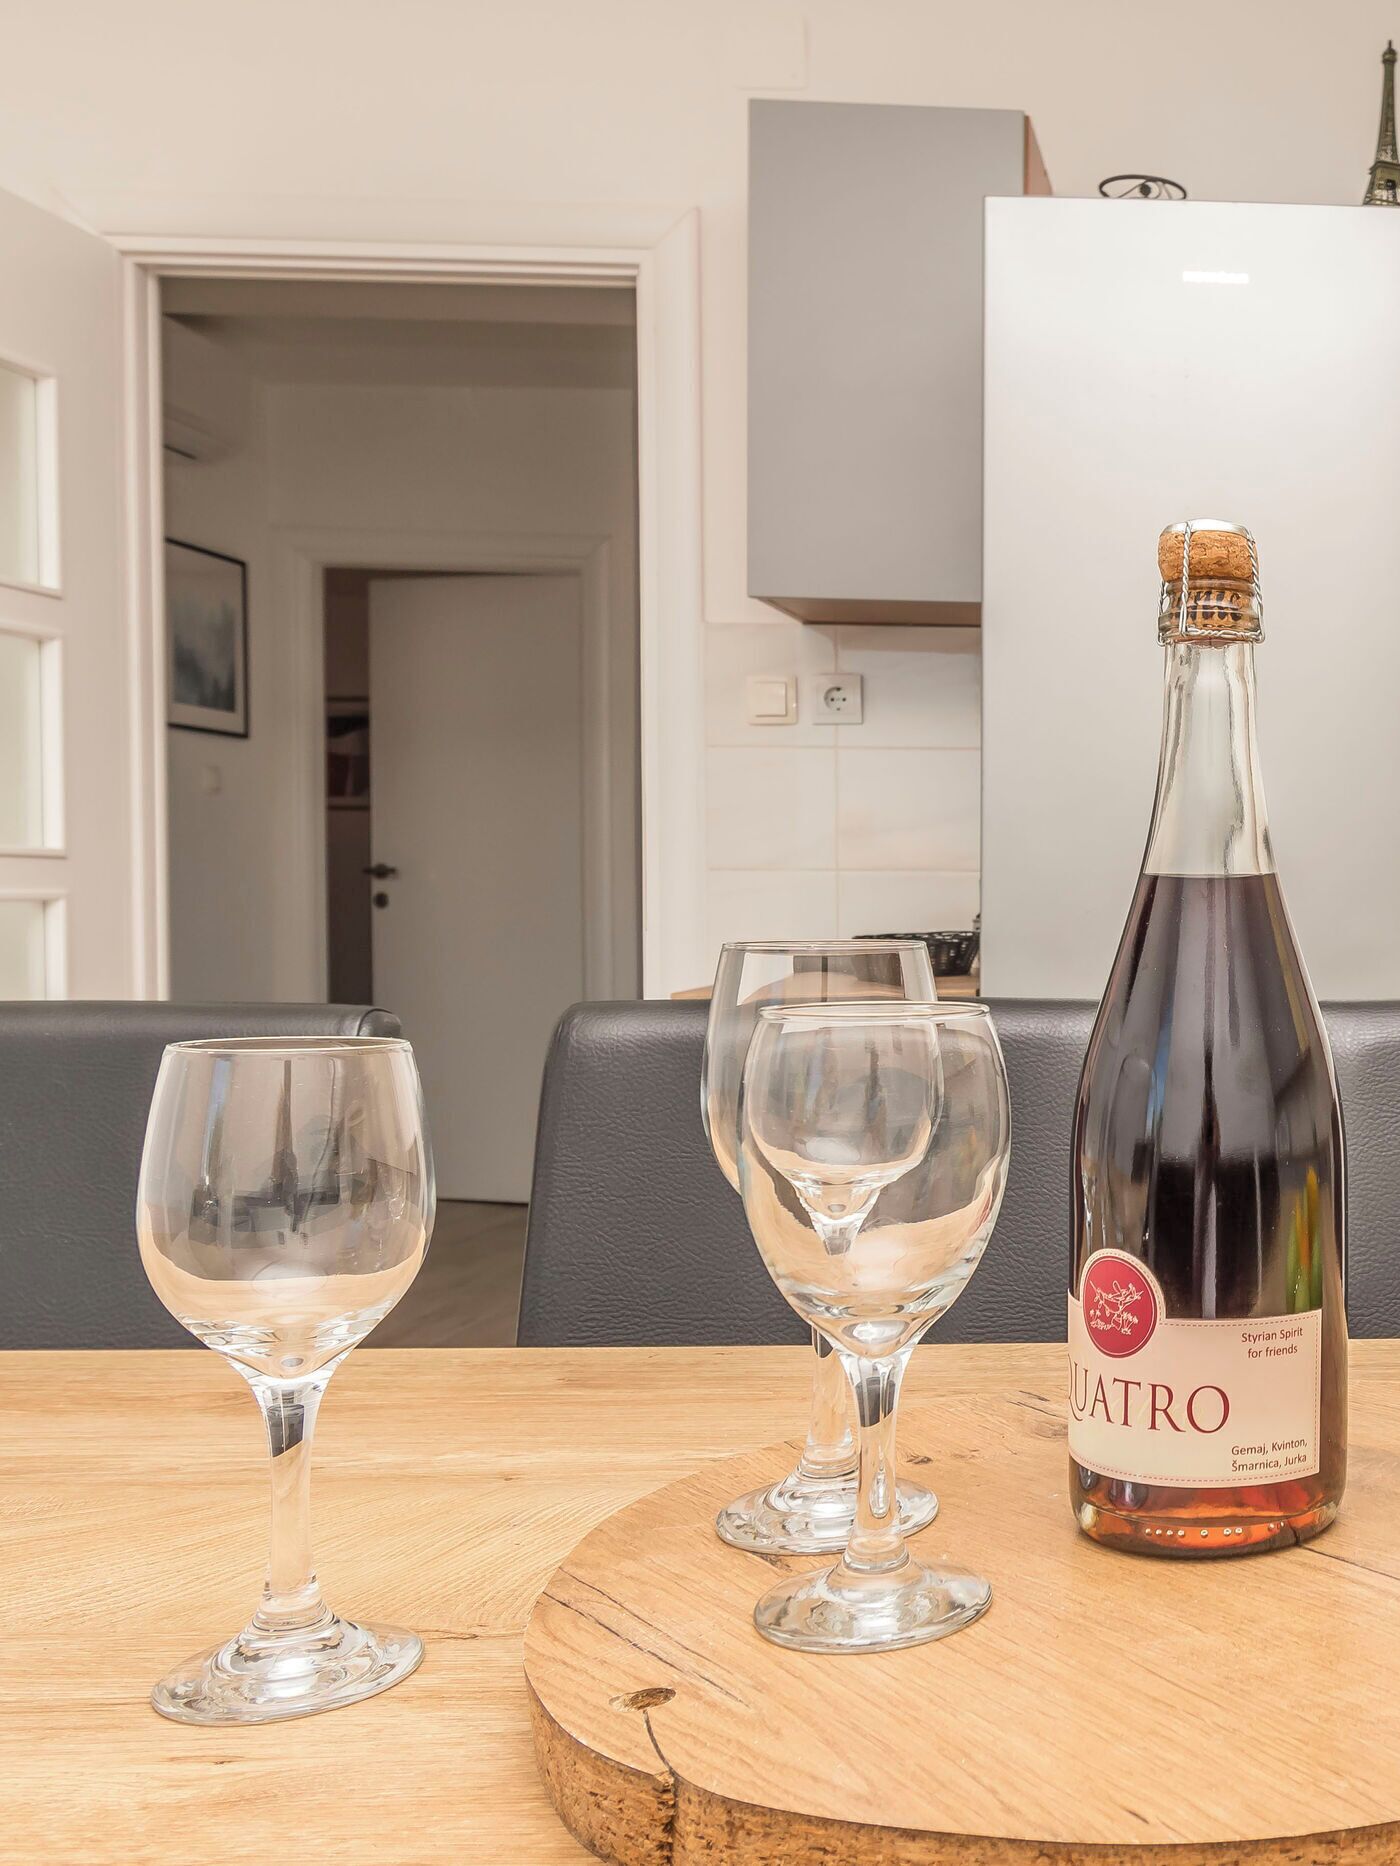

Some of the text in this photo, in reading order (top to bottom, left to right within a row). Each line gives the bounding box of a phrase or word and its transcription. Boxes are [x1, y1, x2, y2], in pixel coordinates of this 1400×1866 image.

[1241, 1327, 1304, 1345] Styrian Spirit
[1247, 1343, 1298, 1359] for friends
[1231, 1438, 1308, 1456] Gemaj, Kvinton,
[1231, 1453, 1307, 1473] Šmarnica, Jurka
